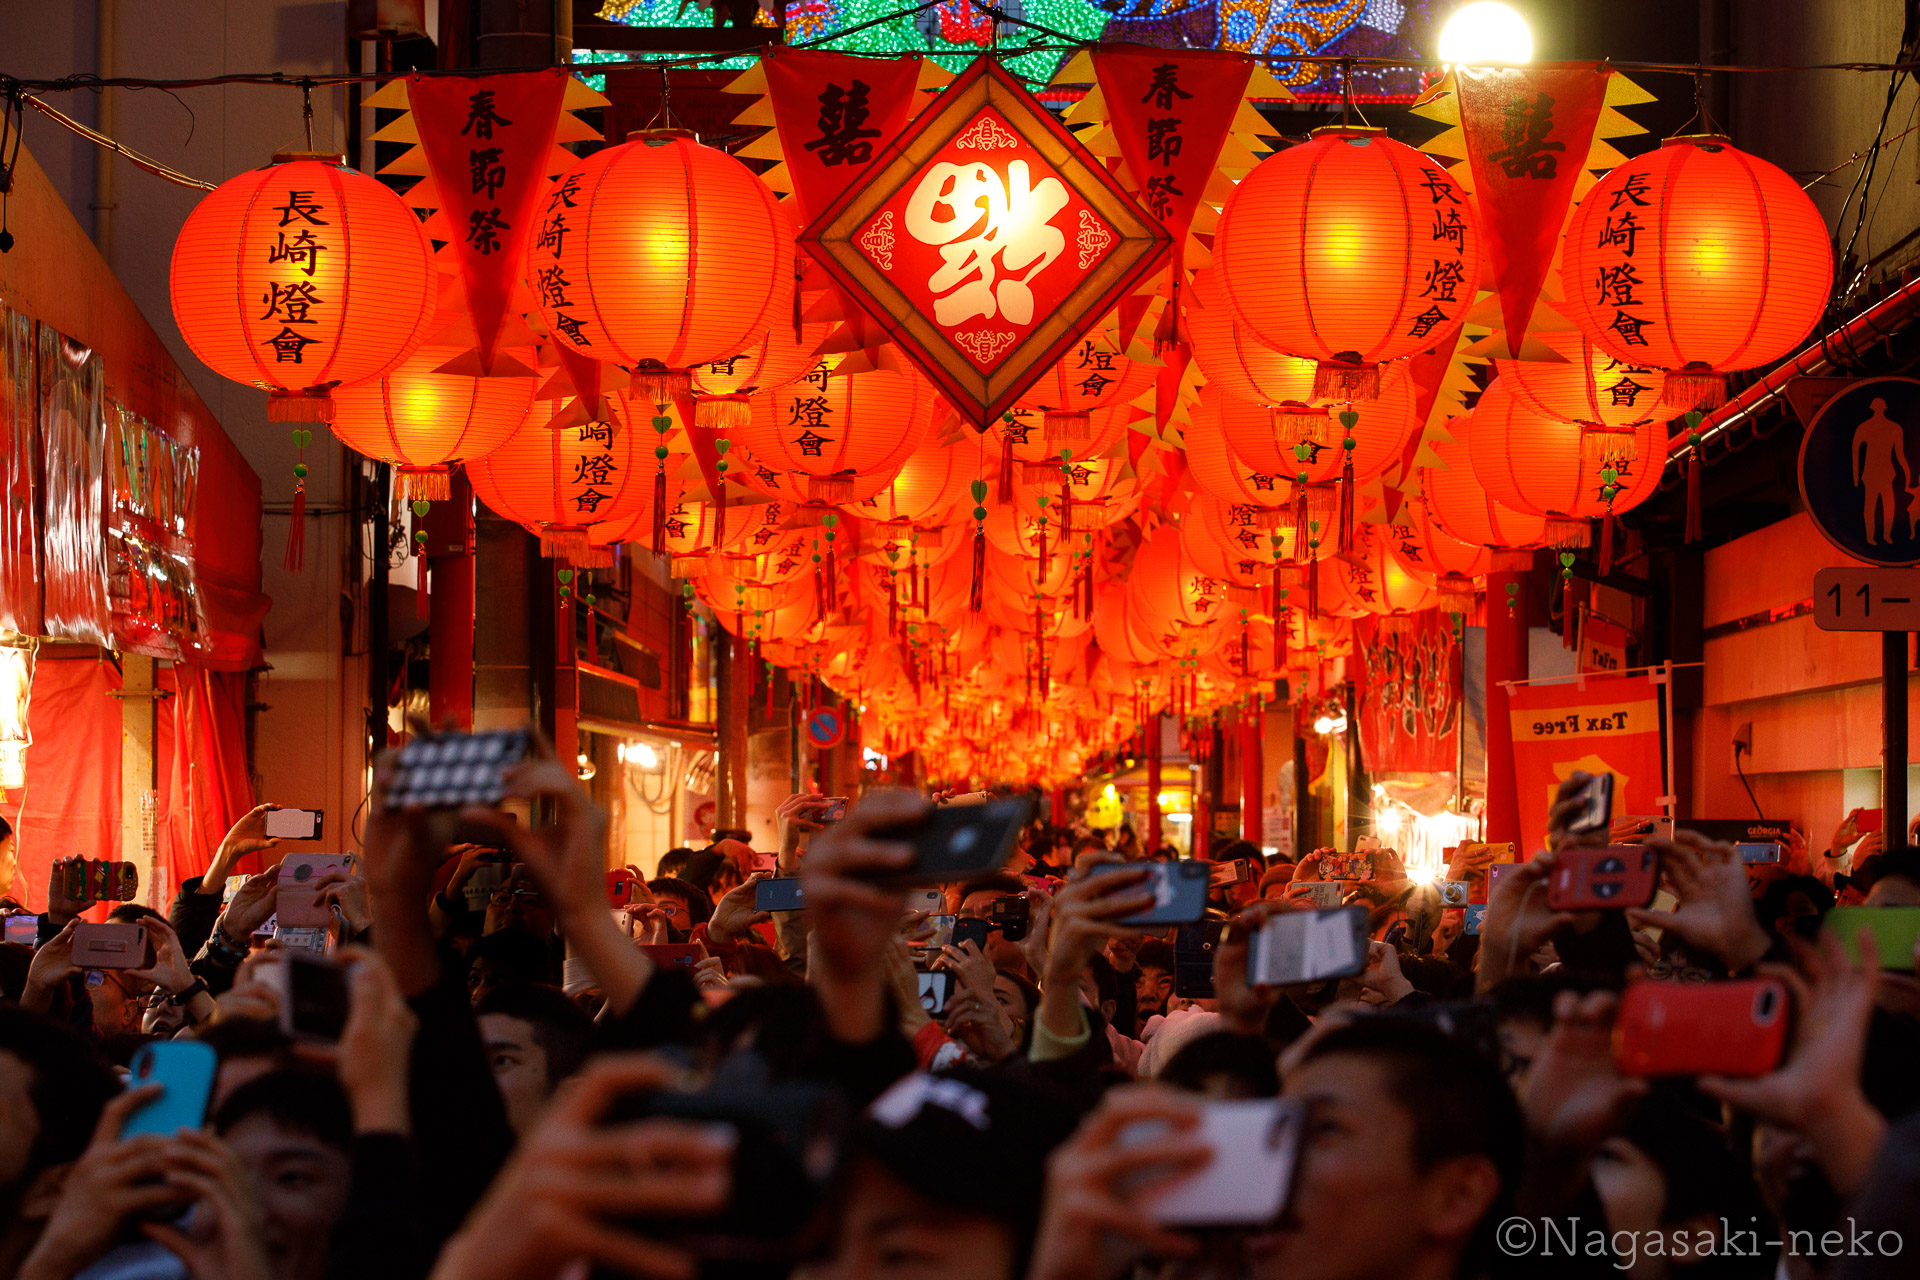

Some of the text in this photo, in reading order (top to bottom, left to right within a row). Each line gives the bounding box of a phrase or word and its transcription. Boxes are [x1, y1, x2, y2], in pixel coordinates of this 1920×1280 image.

[460, 88, 512, 256] 春節祭
[1140, 62, 1194, 222] 春節祭
[262, 190, 330, 364] 長崎燈會
[536, 172, 593, 347] 長崎燈會
[904, 159, 1070, 327] 福
[1406, 167, 1467, 339] 長崎燈會
[1595, 172, 1656, 346] 長崎燈會
